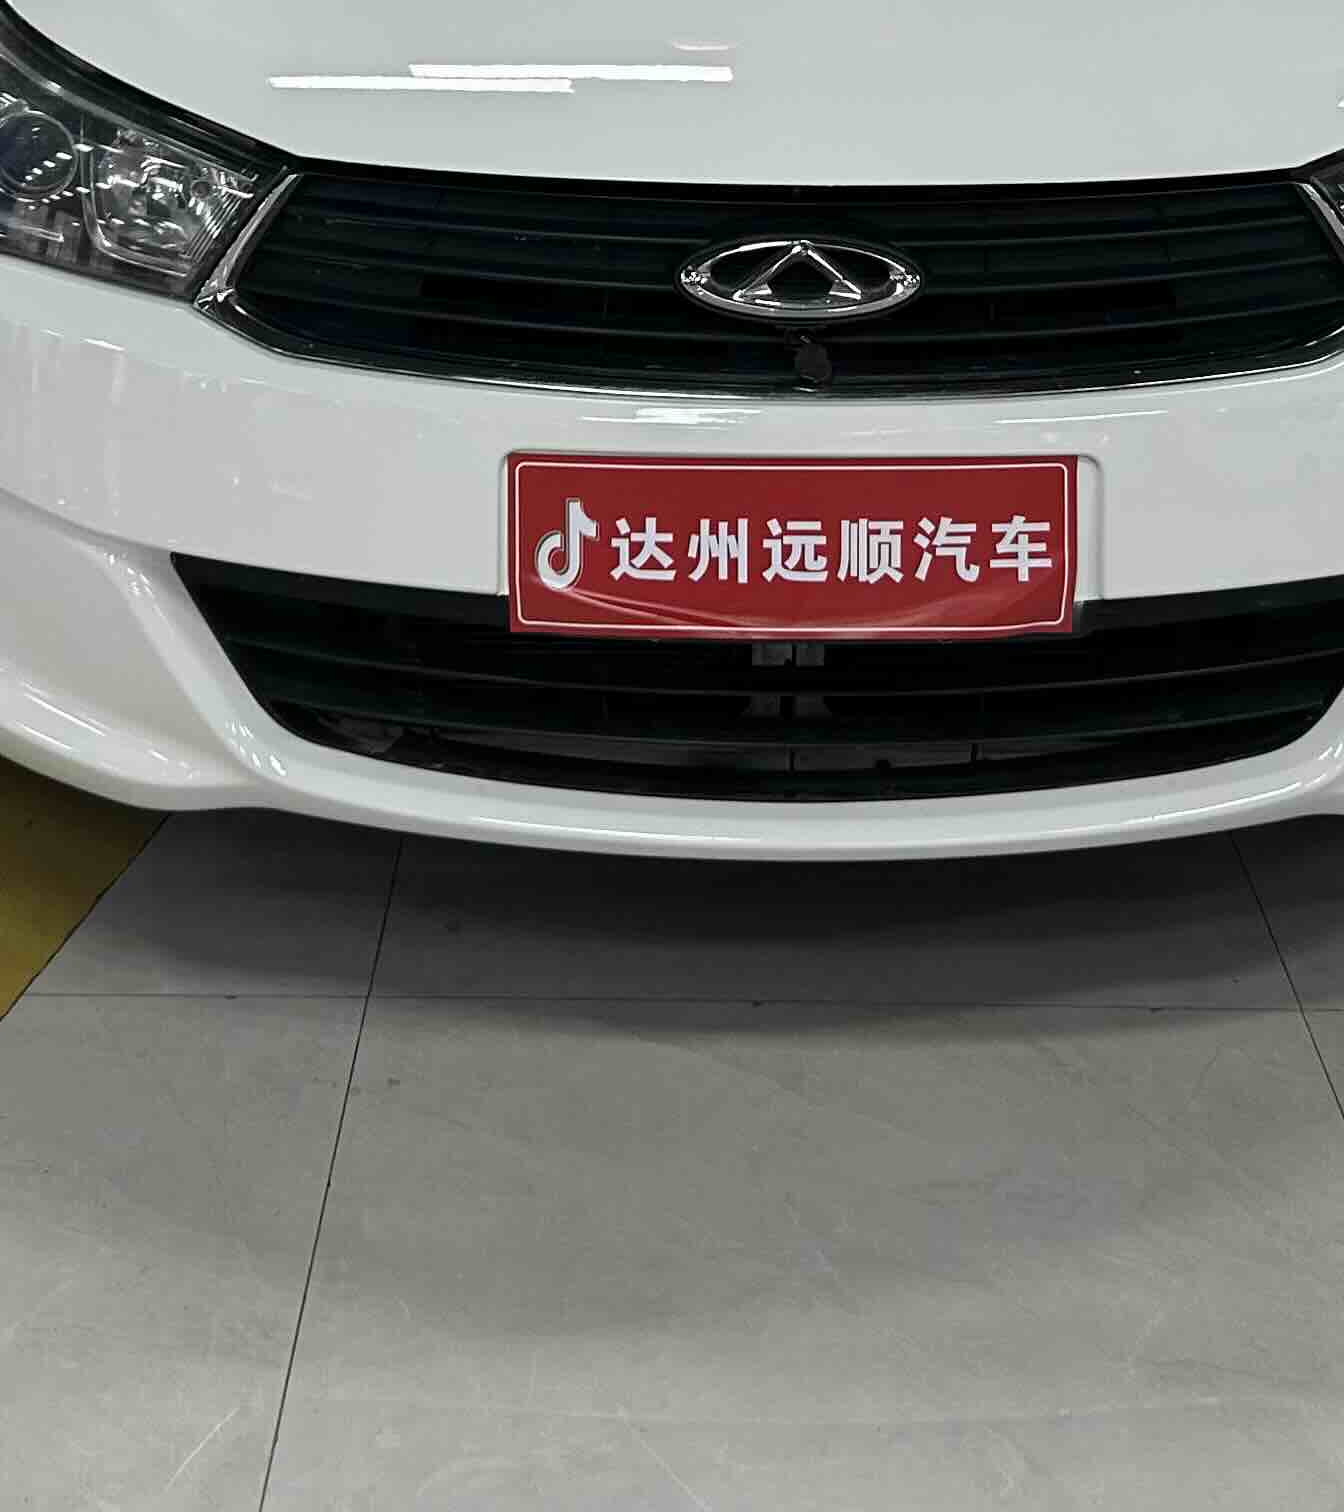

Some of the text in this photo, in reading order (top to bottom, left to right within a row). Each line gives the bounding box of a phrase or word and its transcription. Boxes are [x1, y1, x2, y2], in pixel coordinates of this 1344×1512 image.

[609, 516, 1053, 585] 达州远顺汽车
